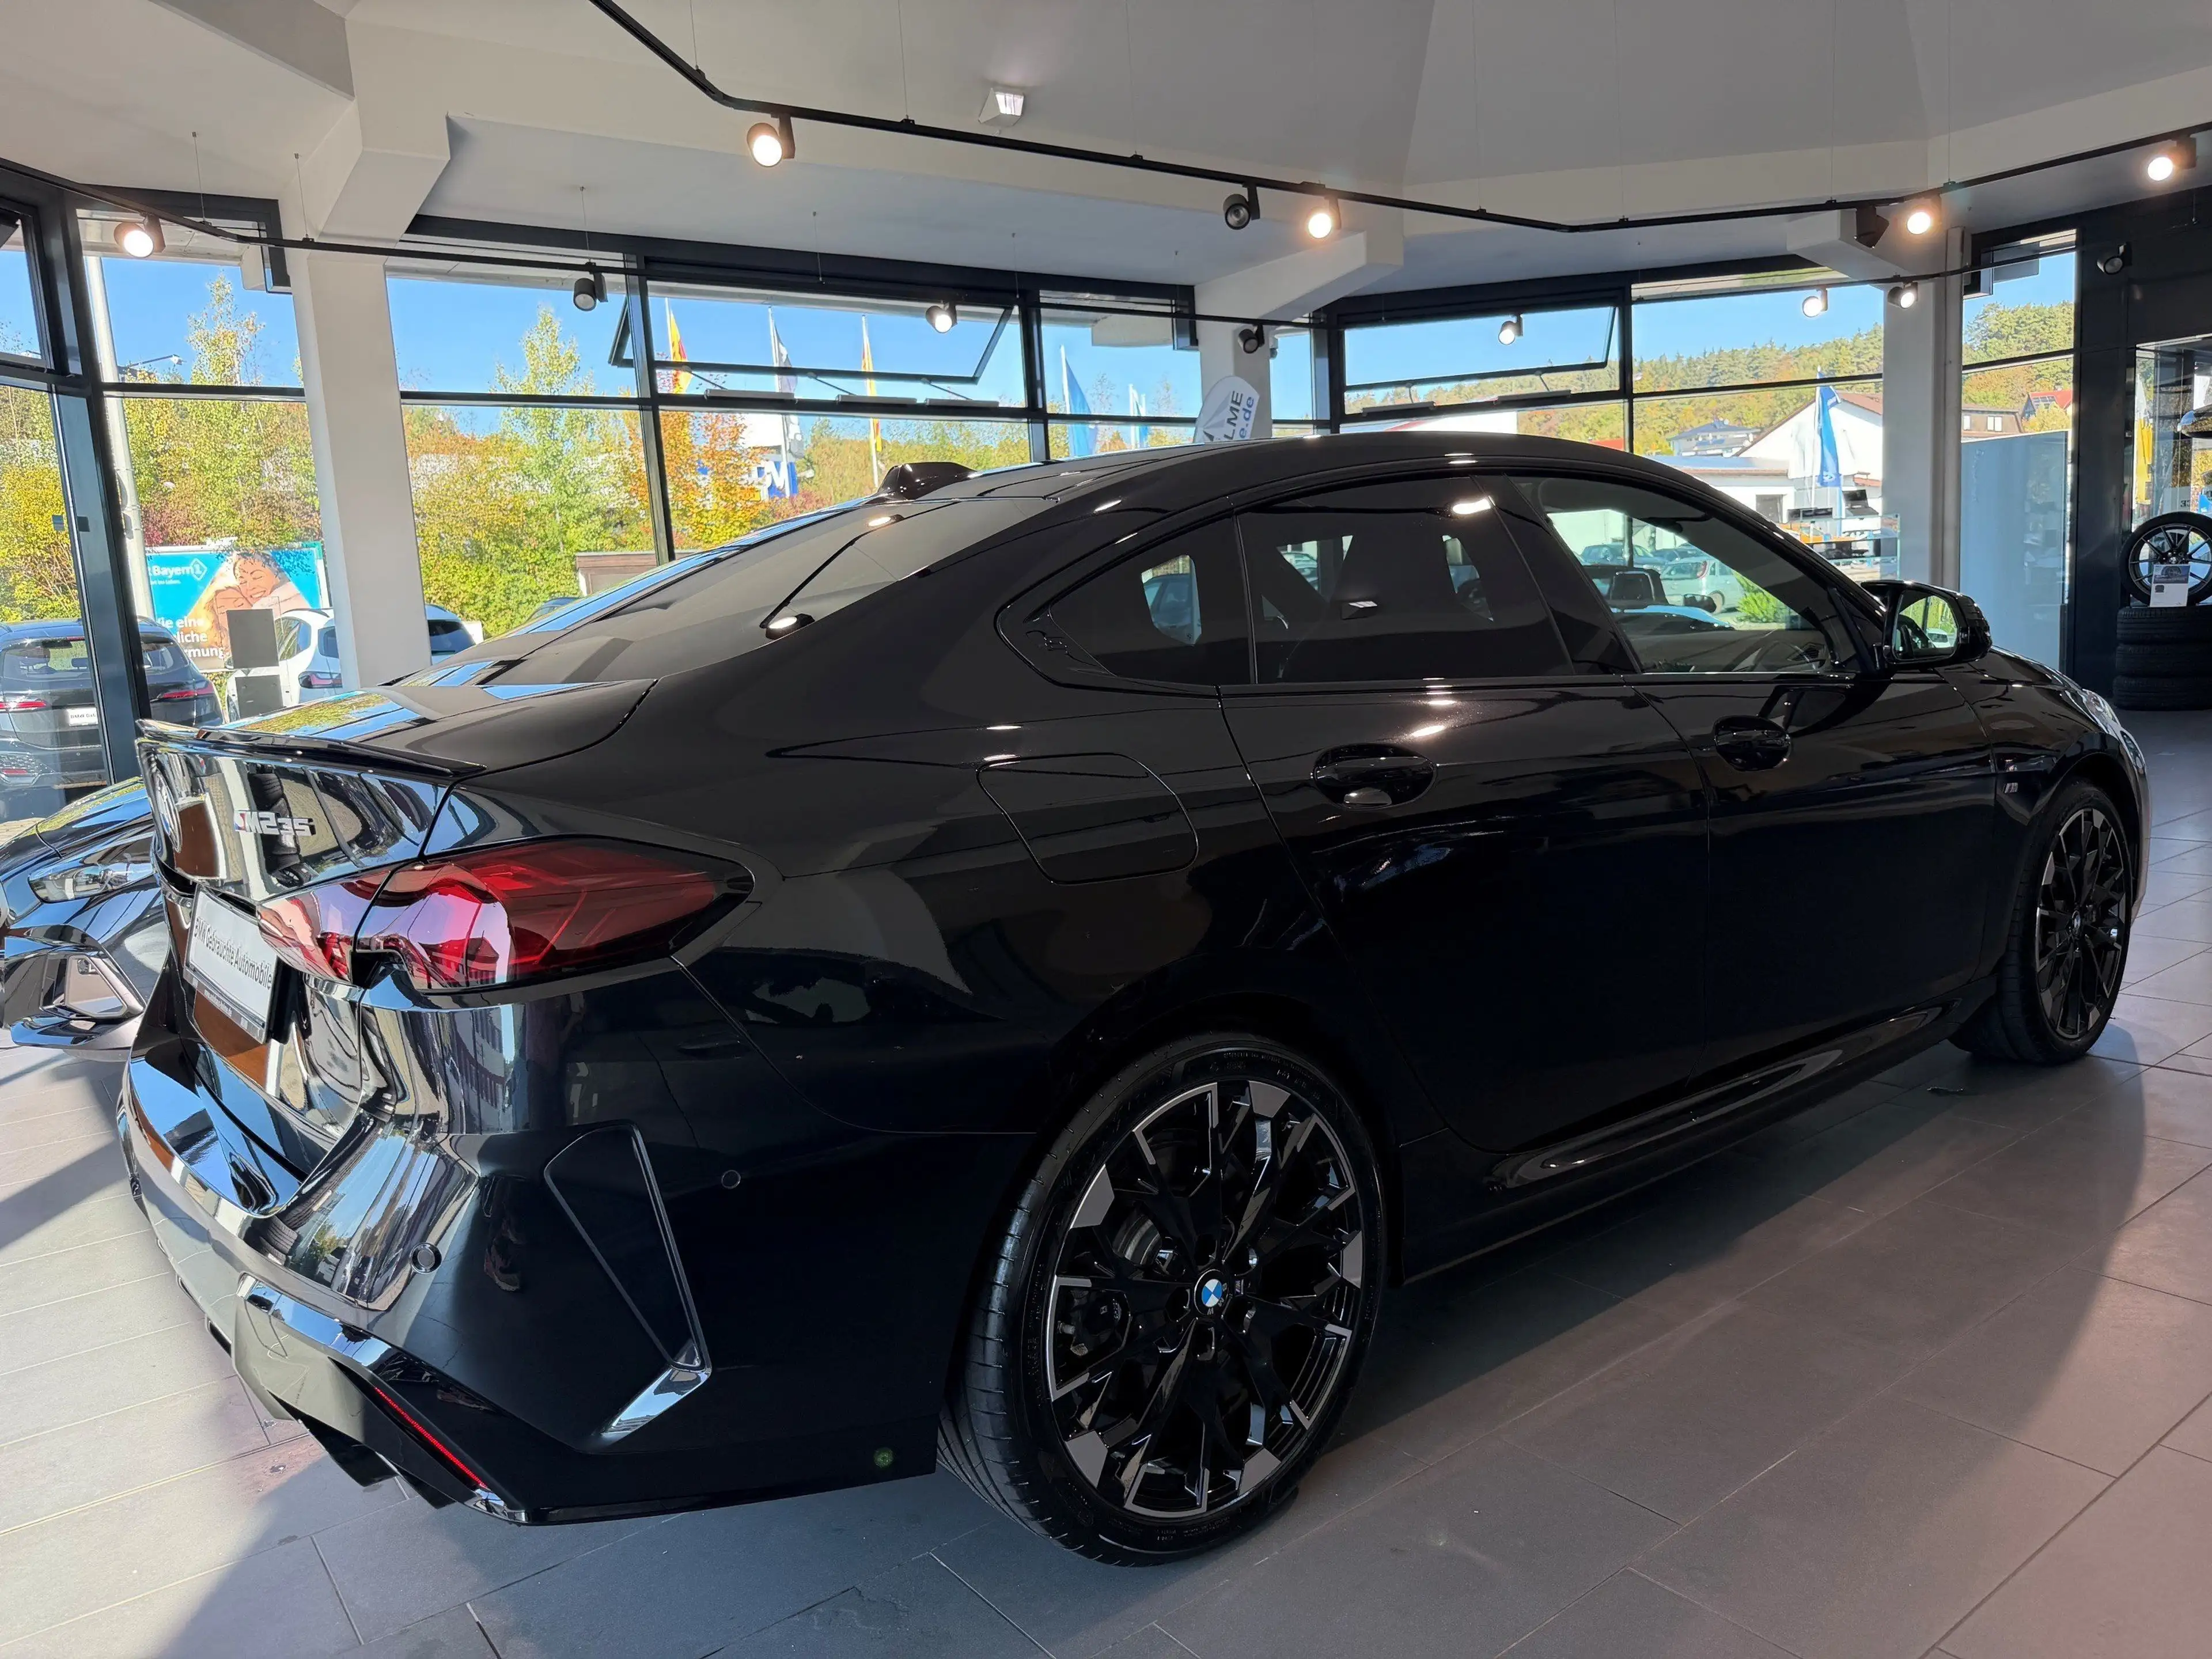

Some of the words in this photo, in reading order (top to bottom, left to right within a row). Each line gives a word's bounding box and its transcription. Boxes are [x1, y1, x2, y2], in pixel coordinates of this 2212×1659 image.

[1223, 391, 1243, 441] LME
[1239, 396, 1254, 439] e.de
[174, 630, 208, 643] liche
[176, 616, 204, 628] eine
[246, 810, 316, 836] M235
[194, 917, 207, 944] BMW
[206, 927, 235, 966] Gebrauchte
[234, 947, 272, 990] Automobile
